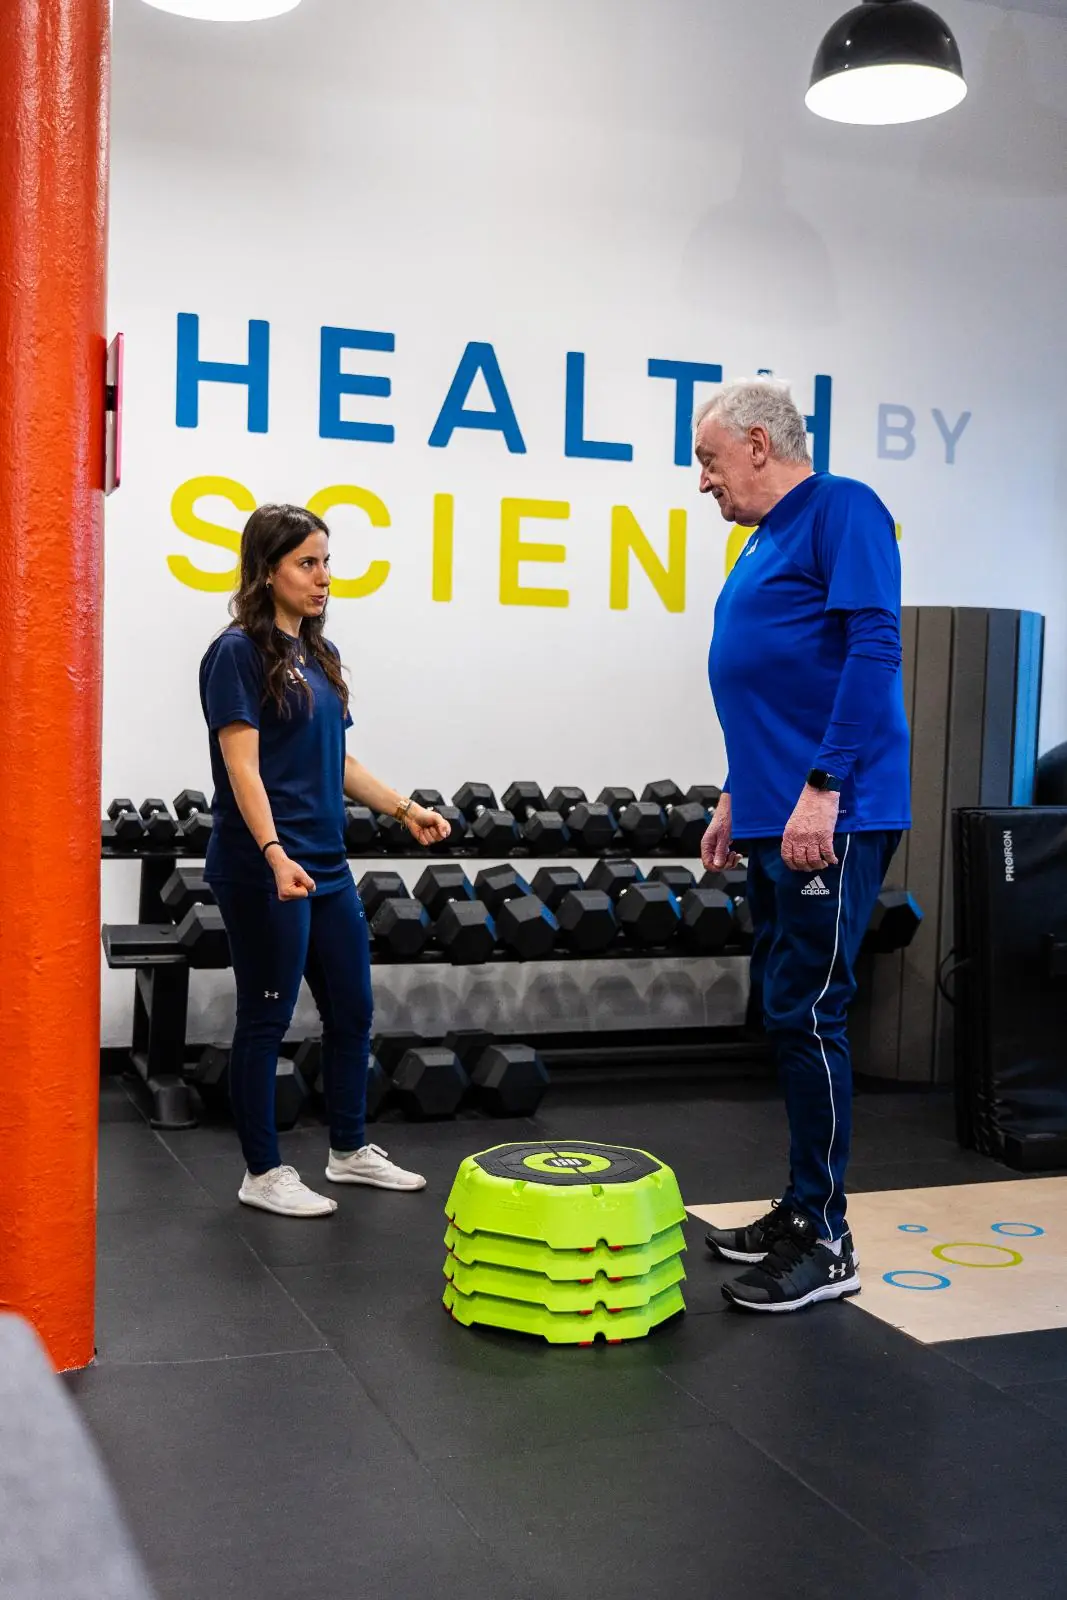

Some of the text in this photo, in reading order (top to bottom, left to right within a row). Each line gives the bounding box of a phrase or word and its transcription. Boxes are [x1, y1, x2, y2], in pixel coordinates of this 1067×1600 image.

[877, 402, 972, 464] BY
[167, 475, 903, 613] SCIEN
[1003, 830, 1014, 881] PROIRON
[801, 888, 830, 896] adidas
